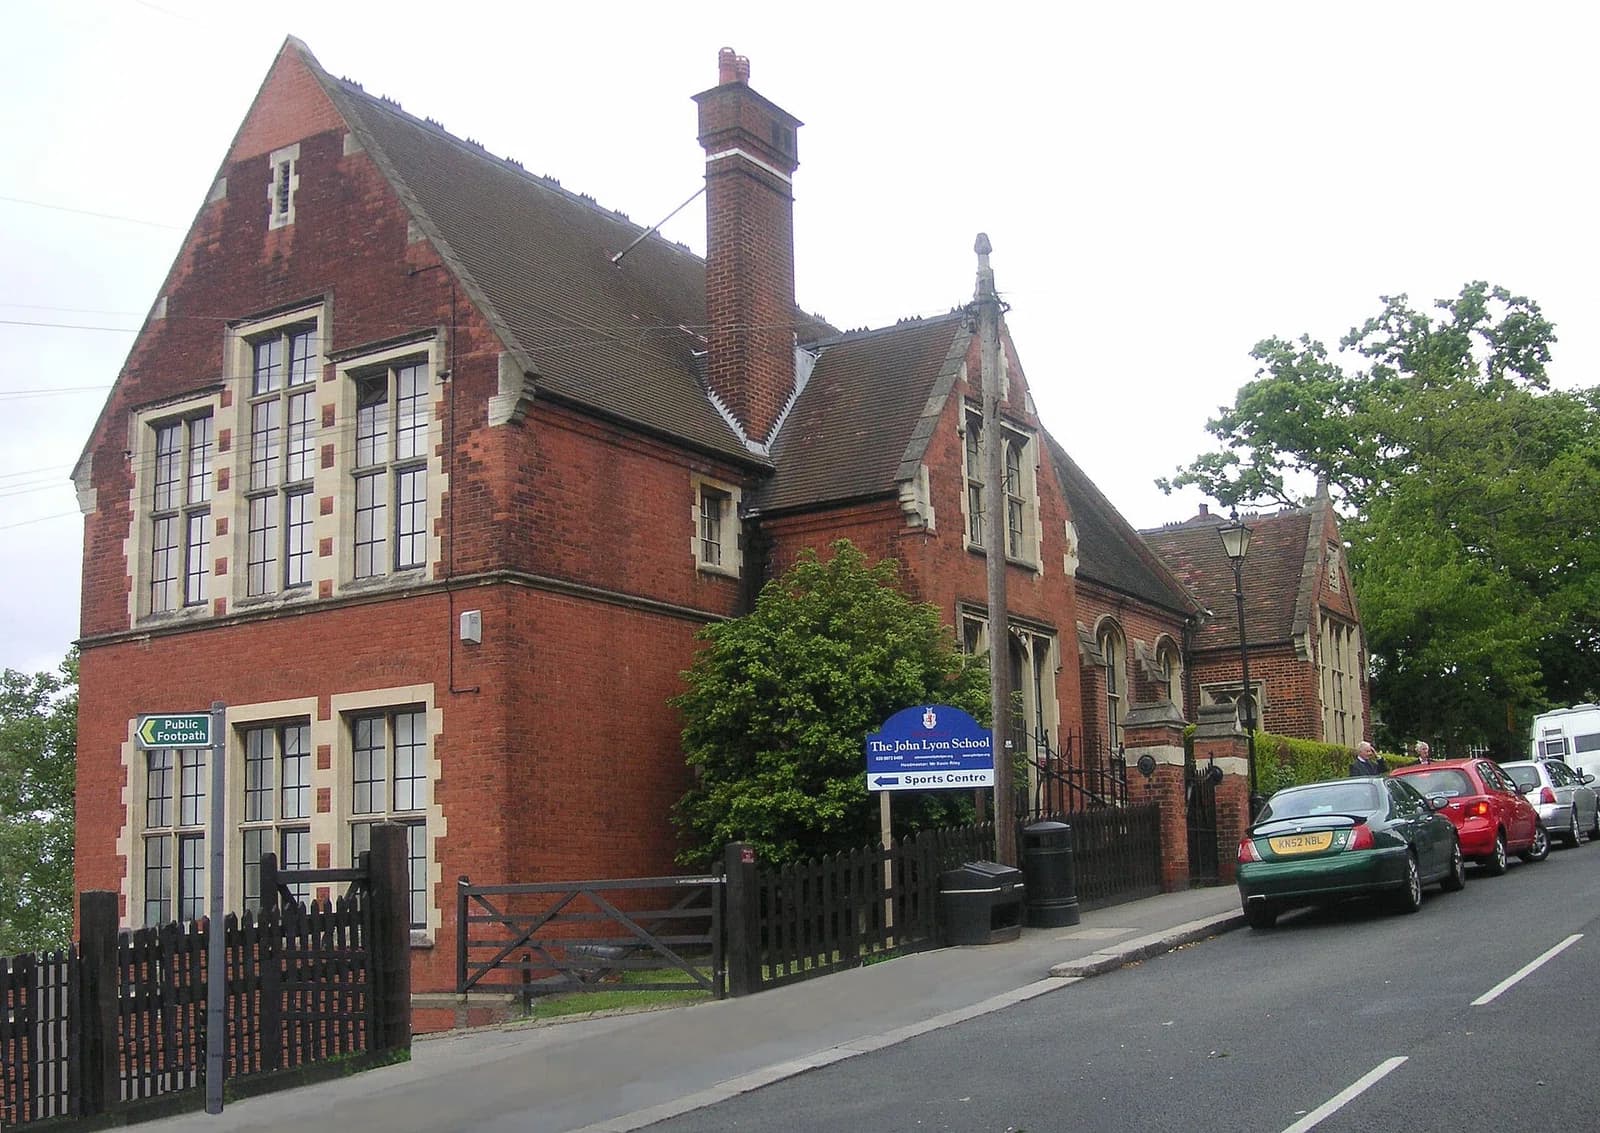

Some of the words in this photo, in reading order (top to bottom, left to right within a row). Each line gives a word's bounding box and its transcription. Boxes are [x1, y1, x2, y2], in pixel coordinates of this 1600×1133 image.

[165, 719, 198, 729] Public
[157, 730, 206, 742] Footpath
[870, 741, 893, 752] The
[893, 739, 920, 753] John
[922, 739, 950, 752] Lyon
[951, 737, 990, 749] School
[904, 775, 944, 786] Sports
[946, 773, 986, 783] Centre
[1278, 838, 1303, 849] KN52
[1304, 836, 1324, 846] NBL
